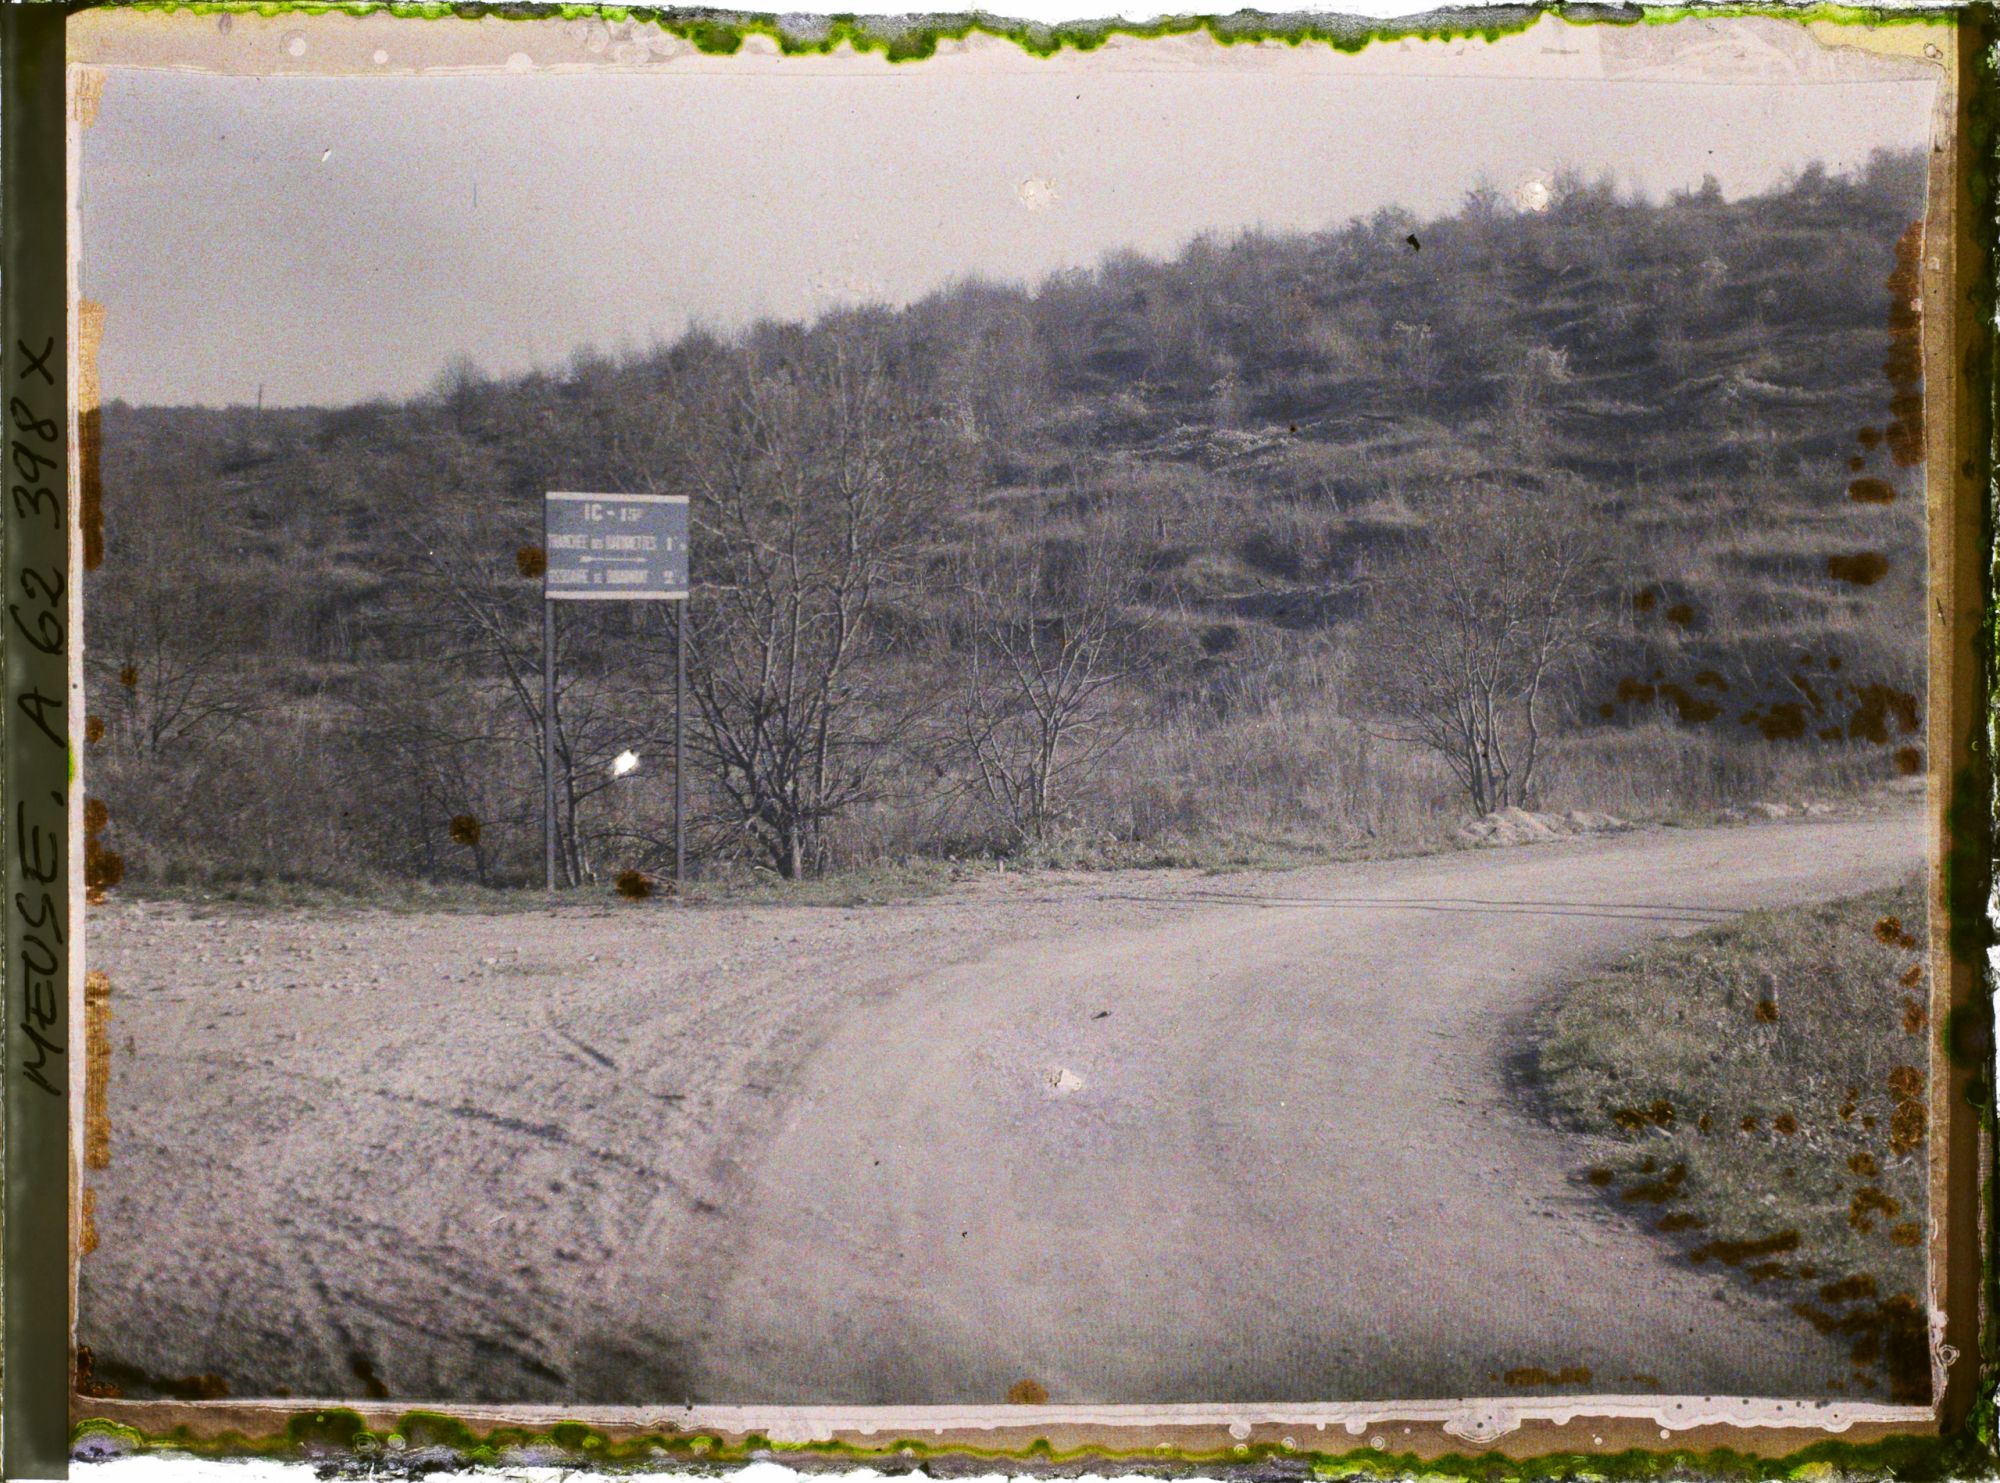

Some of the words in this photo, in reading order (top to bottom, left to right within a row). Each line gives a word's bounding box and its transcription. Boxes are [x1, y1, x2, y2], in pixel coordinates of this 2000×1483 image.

[17, 336, 55, 386] X
[10, 396, 60, 530] 398
[10, 567, 66, 656] 62
[17, 685, 66, 749] A
